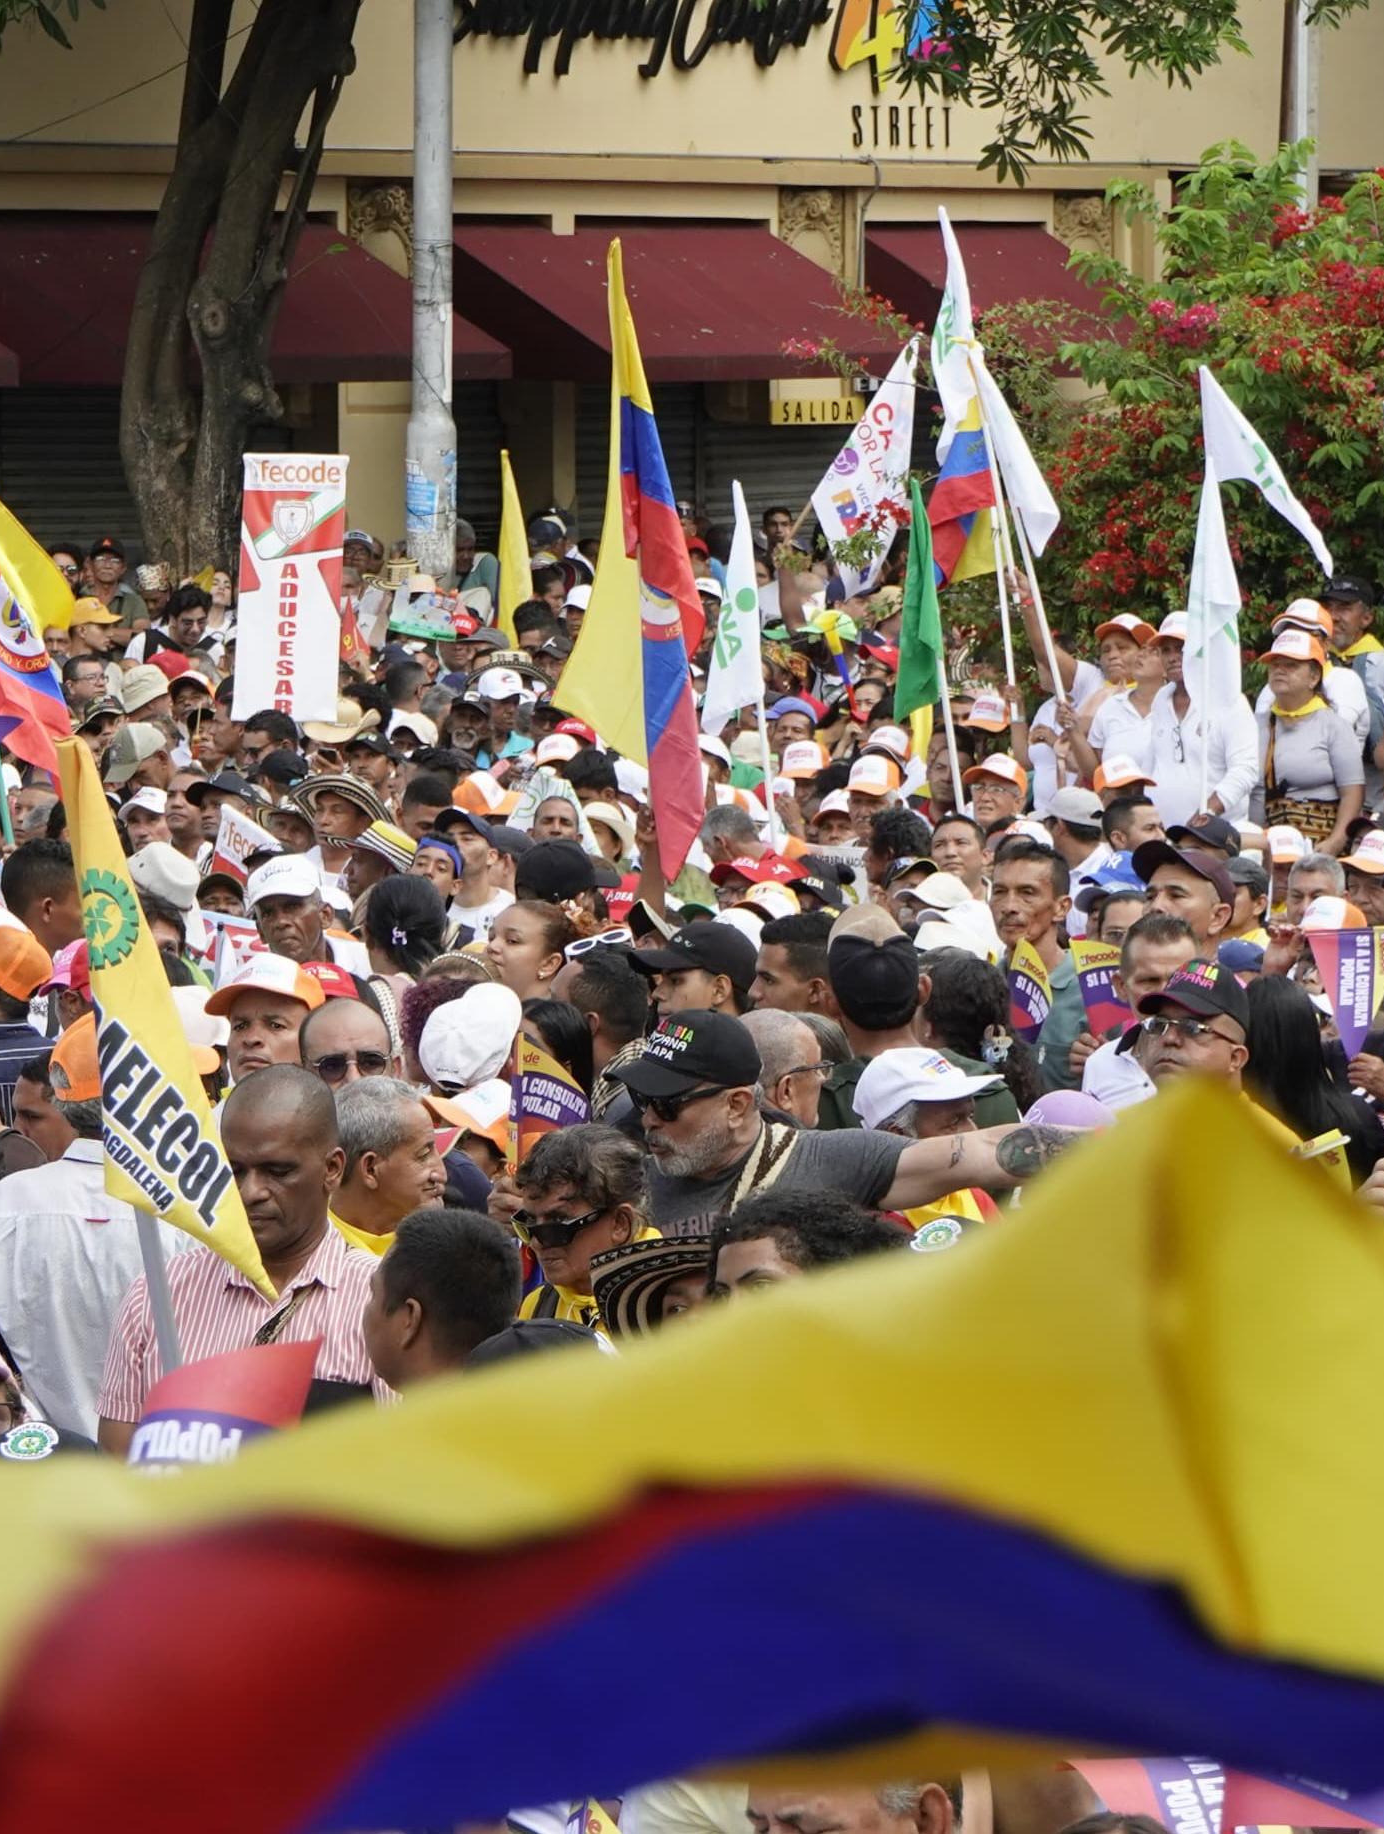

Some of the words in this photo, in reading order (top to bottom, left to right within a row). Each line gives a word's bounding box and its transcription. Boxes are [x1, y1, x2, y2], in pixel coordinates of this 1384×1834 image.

[851, 104, 953, 148] STREET
[783, 400, 854, 422] SALIDA
[260, 460, 341, 484] fecode
[1340, 957, 1356, 1007] POPULAR
[1353, 981, 1371, 1028] CONSULTA
[529, 1076, 588, 1119] CONSULTA
[97, 1016, 233, 1228] AELECOL
[102, 1126, 175, 1212] AGDALENA
